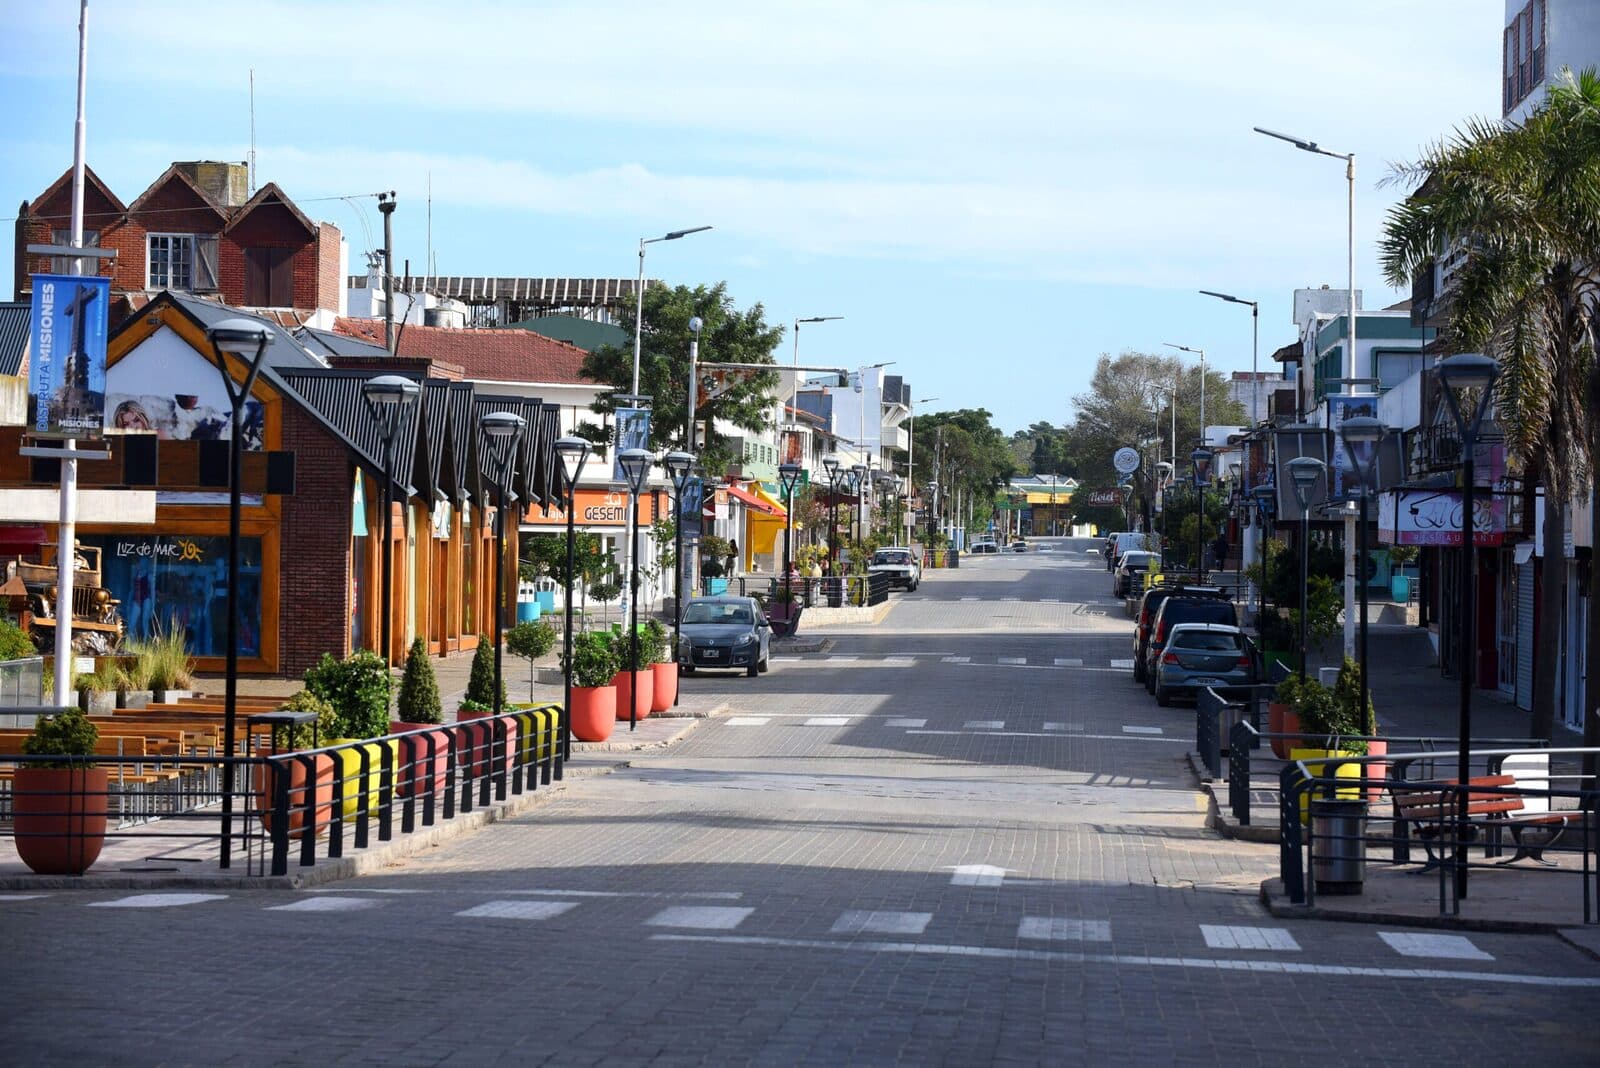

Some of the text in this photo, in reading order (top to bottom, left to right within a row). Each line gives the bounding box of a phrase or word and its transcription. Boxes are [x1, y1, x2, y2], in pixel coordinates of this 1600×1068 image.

[36, 283, 55, 432] DISFRUTA MISIONES
[59, 419, 99, 428] MISIONES
[1414, 534, 1495, 542] RESTAUANT
[117, 542, 179, 558] LUZ de MAR
